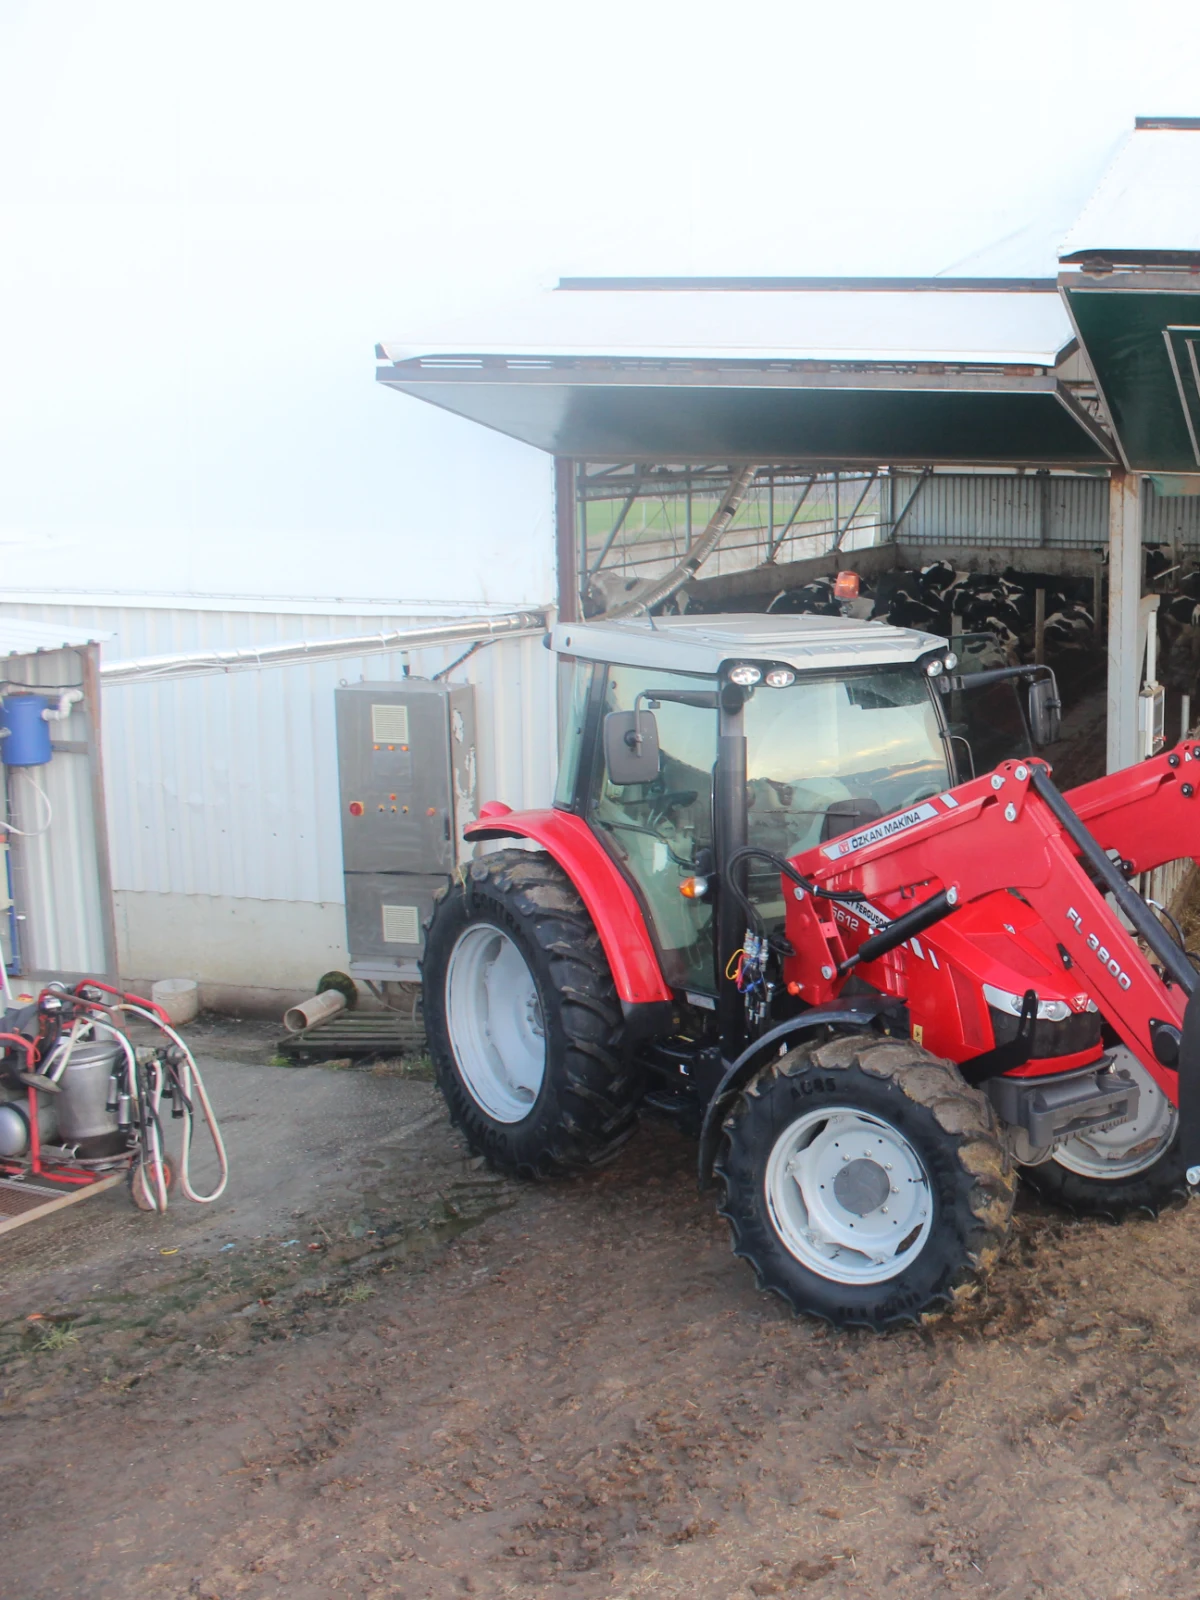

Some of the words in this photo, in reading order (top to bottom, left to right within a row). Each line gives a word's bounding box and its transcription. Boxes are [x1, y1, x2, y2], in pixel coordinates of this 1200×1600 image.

[851, 830, 882, 849] ÖZKAN
[884, 811, 921, 834] MAKİNA
[1065, 906, 1082, 935] FL
[1086, 932, 1132, 992] 3800
